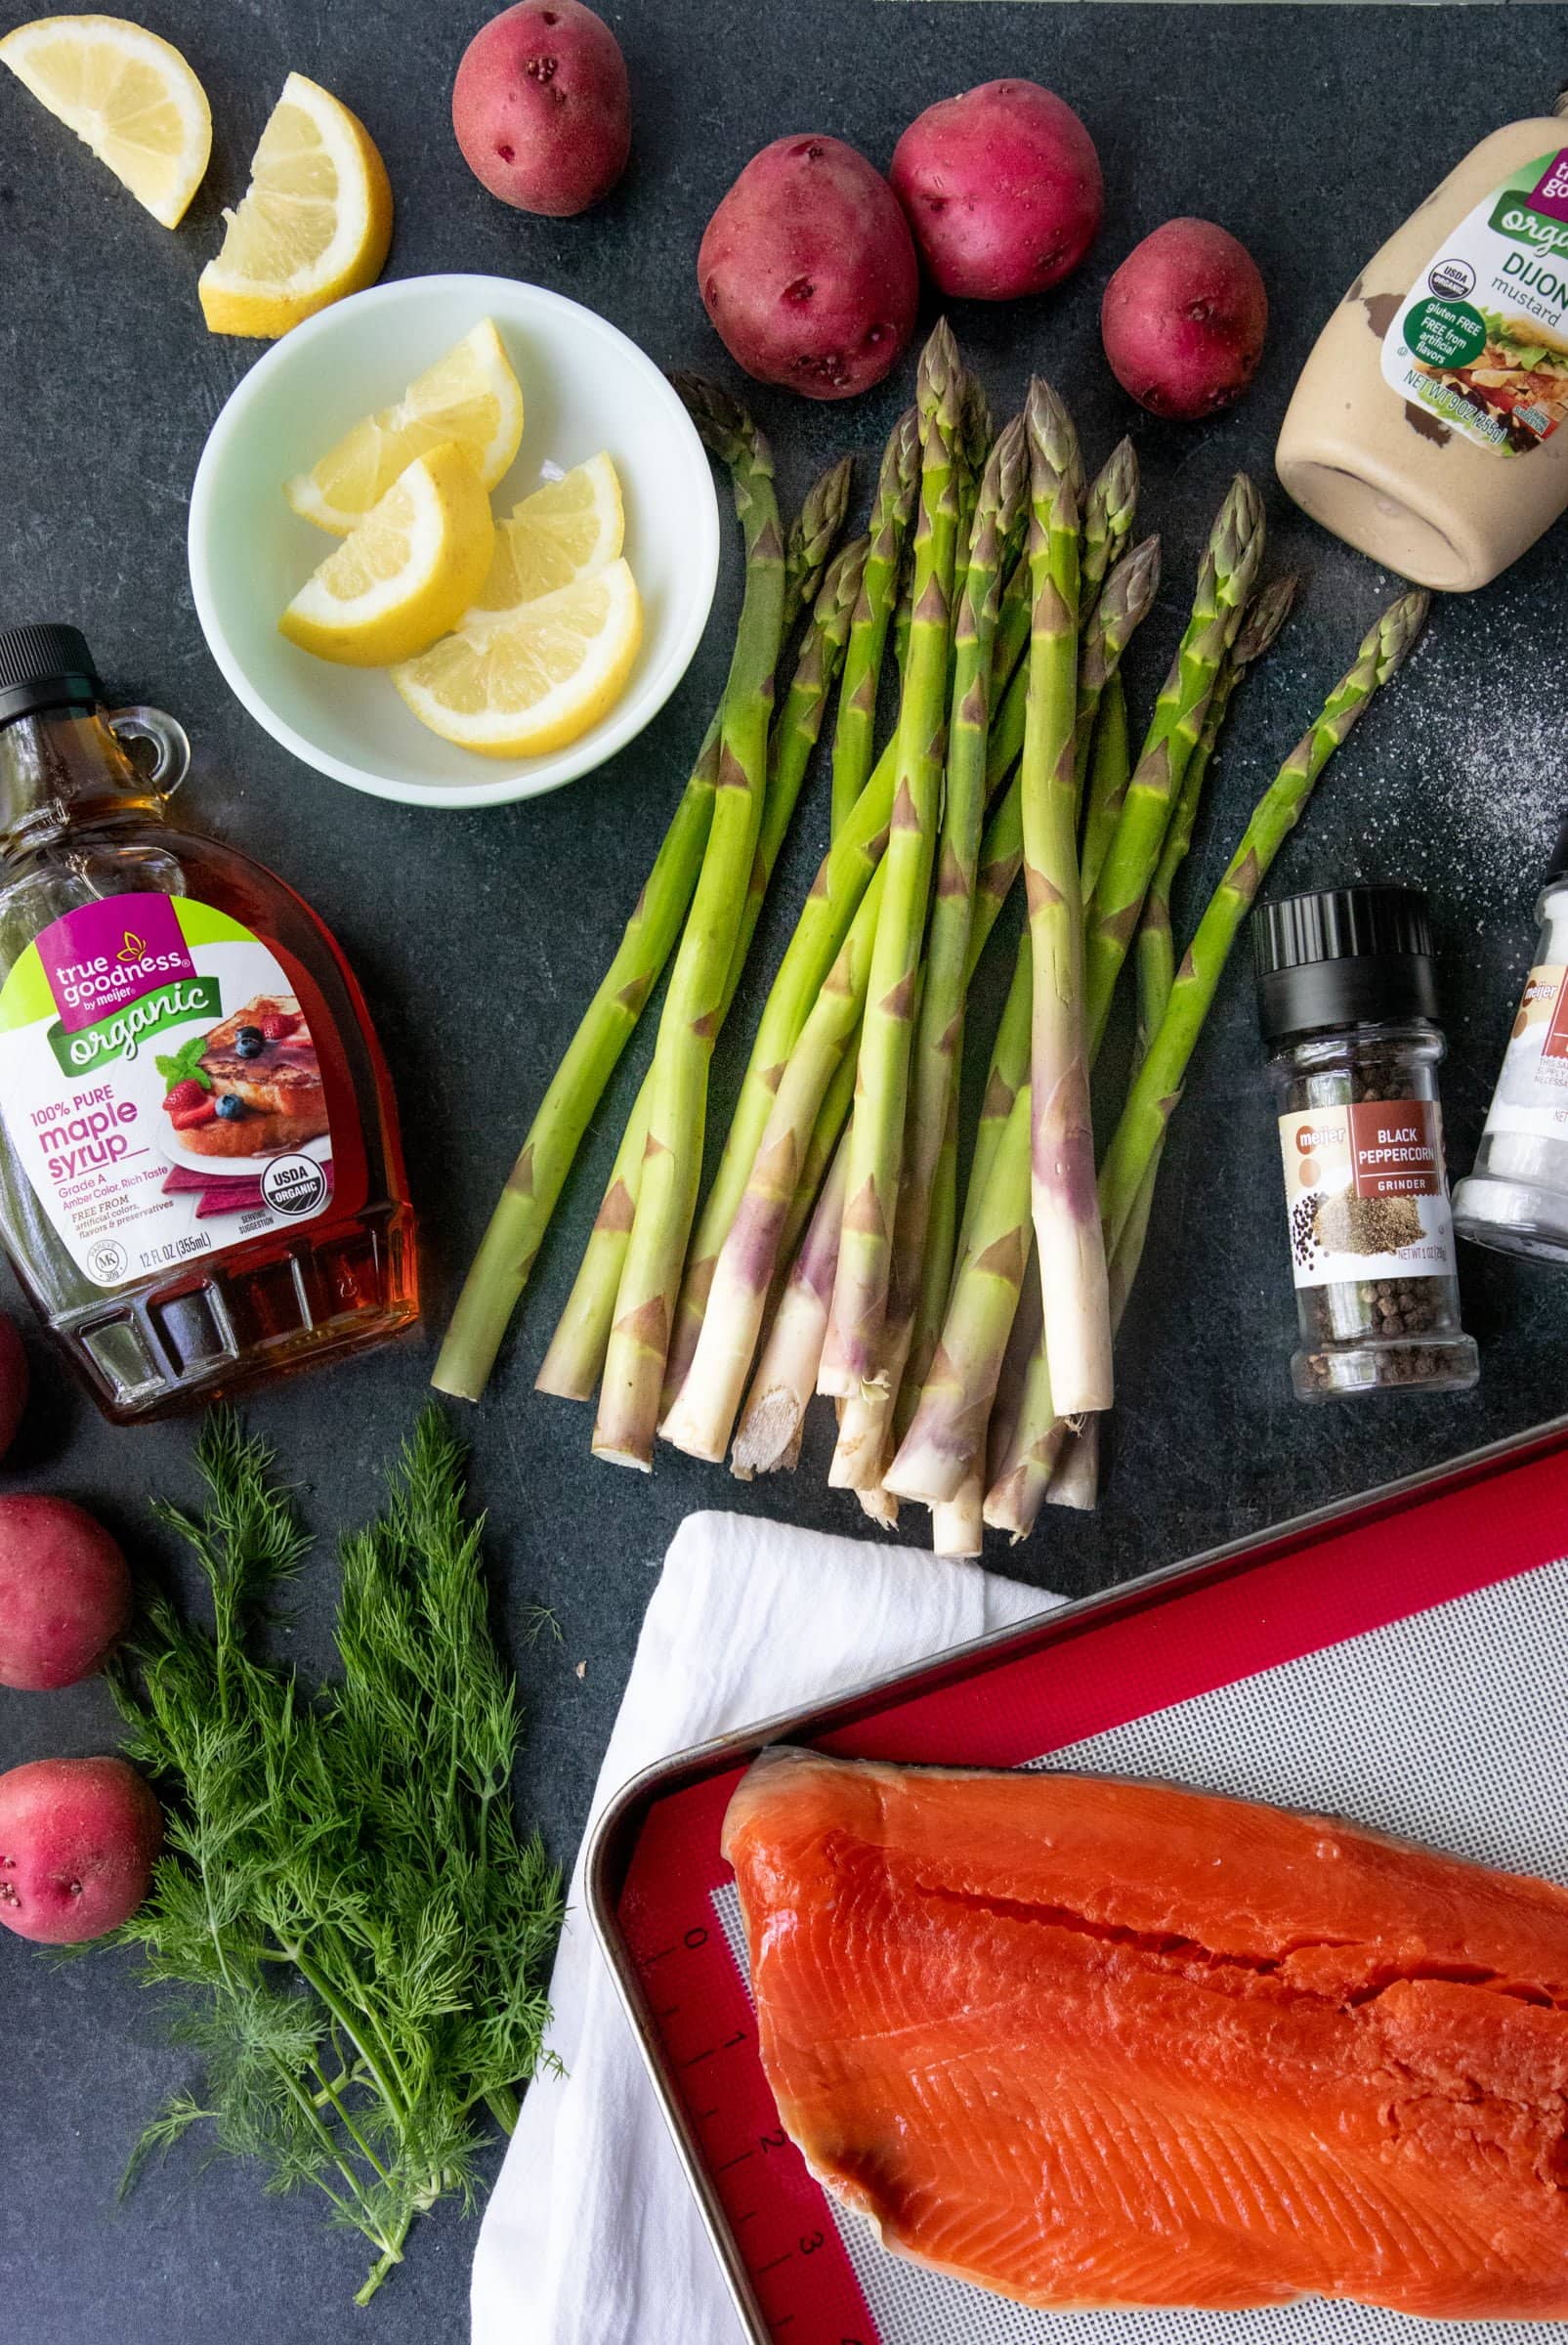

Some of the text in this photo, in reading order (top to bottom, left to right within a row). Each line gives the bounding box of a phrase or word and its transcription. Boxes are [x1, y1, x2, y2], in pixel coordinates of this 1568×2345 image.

[1444, 266, 1467, 283] USDA
[1491, 277, 1561, 327] mustard
[1425, 302, 1482, 336] gluten FREE
[1420, 317, 1466, 349] FREE from
[1420, 331, 1458, 356] artificial
[1416, 340, 1446, 363] flavors
[1403, 369, 1508, 445] NET WT 9 OZ (255g)
[57, 957, 108, 985] true
[83, 986, 131, 1010] by meijer
[70, 982, 209, 1060] organic
[30, 1085, 114, 1127] 100% PURE
[39, 1102, 138, 1153] maple
[1300, 1126, 1345, 1147] meijer
[1377, 1129, 1418, 1143] BLACK
[48, 1134, 128, 1179] syrup
[1359, 1147, 1434, 1165] PEPPERCORN
[59, 1173, 106, 1199] Grade A
[274, 1166, 309, 1186] USDA
[1377, 1179, 1426, 1191] GRINDER
[64, 1195, 93, 1211] Amber
[121, 1175, 143, 1189] Rich
[143, 1167, 168, 1181] Taste
[275, 1180, 318, 1204] ORGANIC
[71, 1194, 130, 1222] FREE FROM
[79, 1223, 107, 1239] flavors
[116, 1200, 174, 1227] preservatives
[240, 1210, 267, 1223] SERVING
[75, 1213, 109, 1231] artificial
[238, 1216, 275, 1234] SUGGESTION
[99, 1253, 116, 1268] MK
[140, 1231, 211, 1268] 12 FL OZ (355mL)
[1398, 1248, 1410, 1259] NET
[685, 1926, 709, 1950] 0
[723, 2030, 747, 2049] 1
[760, 2127, 786, 2154] 2
[800, 2229, 826, 2256] 3
